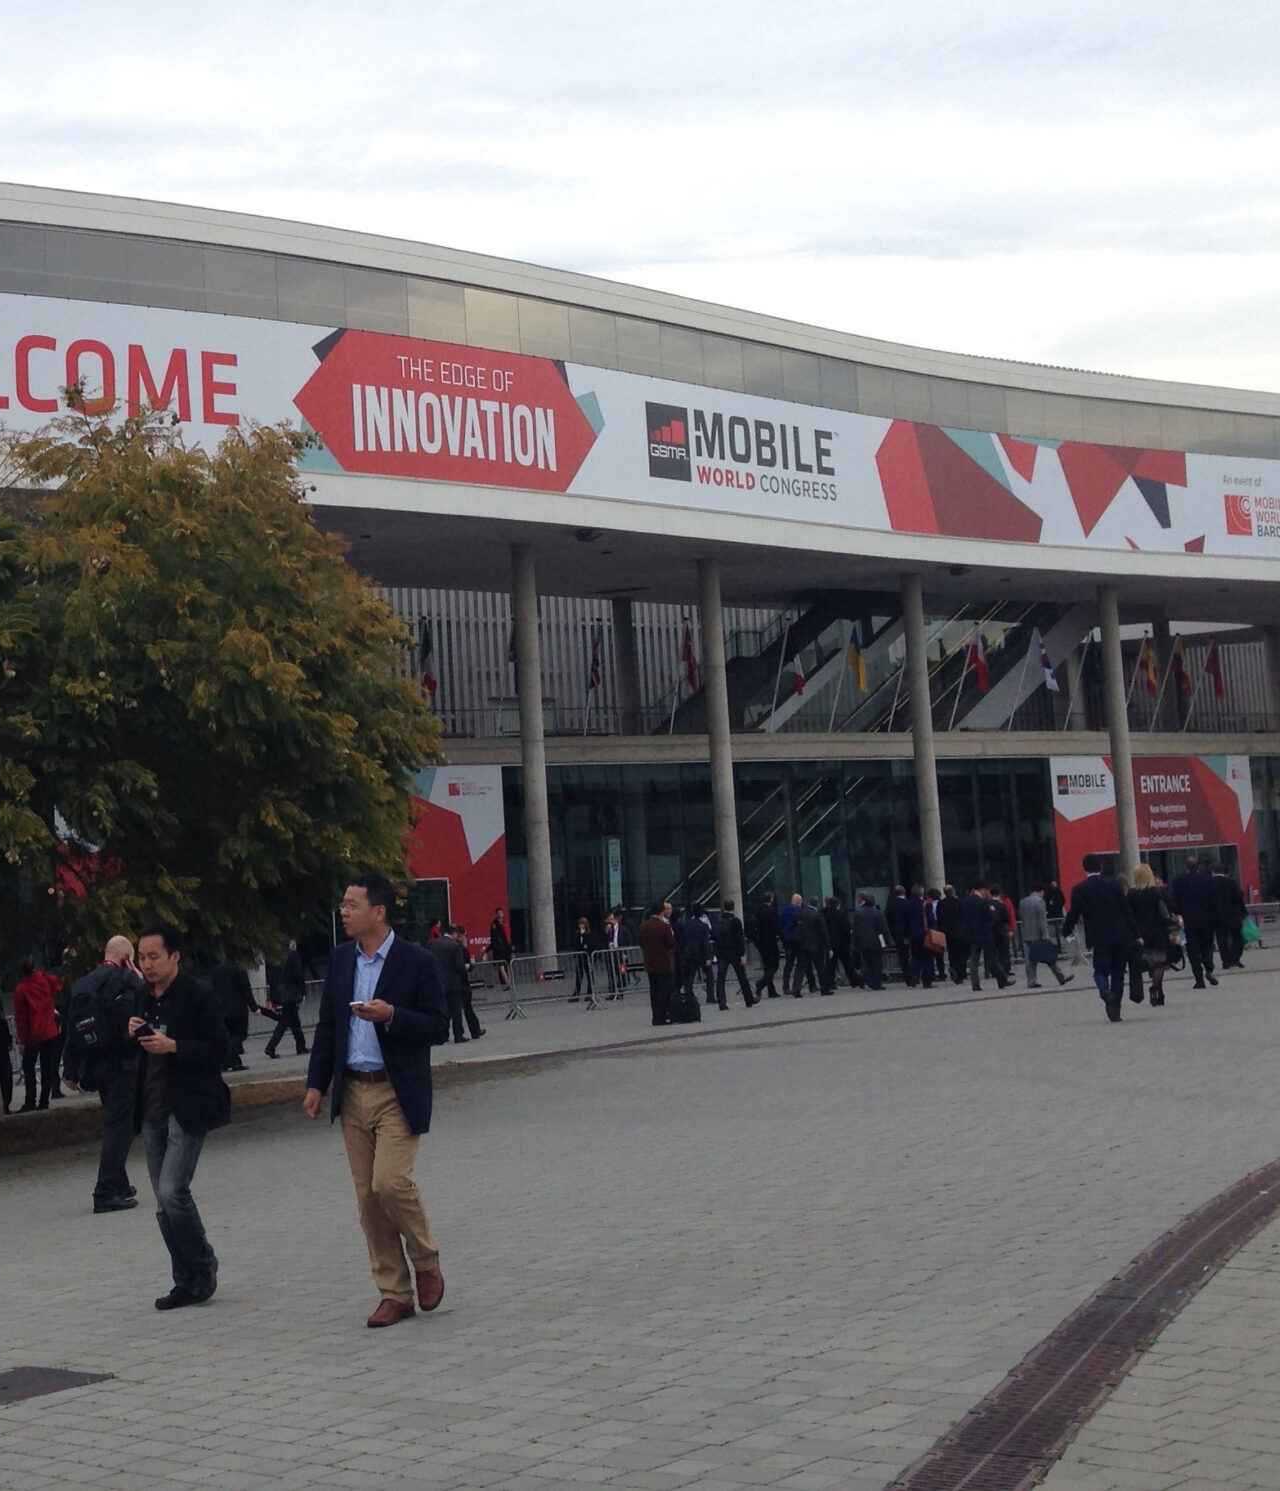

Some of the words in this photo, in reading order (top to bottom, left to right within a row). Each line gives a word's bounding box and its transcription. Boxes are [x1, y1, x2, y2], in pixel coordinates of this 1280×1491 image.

[397, 355, 434, 382] THE
[440, 361, 488, 390] EDGE
[492, 369, 514, 392] OF
[351, 383, 558, 472] INNOVATION
[693, 409, 836, 477] MOBILE
[649, 443, 688, 460] GSMA
[696, 465, 756, 491] WORLD
[759, 474, 838, 501] CONGRESS
[1069, 774, 1107, 788] MOBILE
[1140, 774, 1192, 794] ENTRANCE
